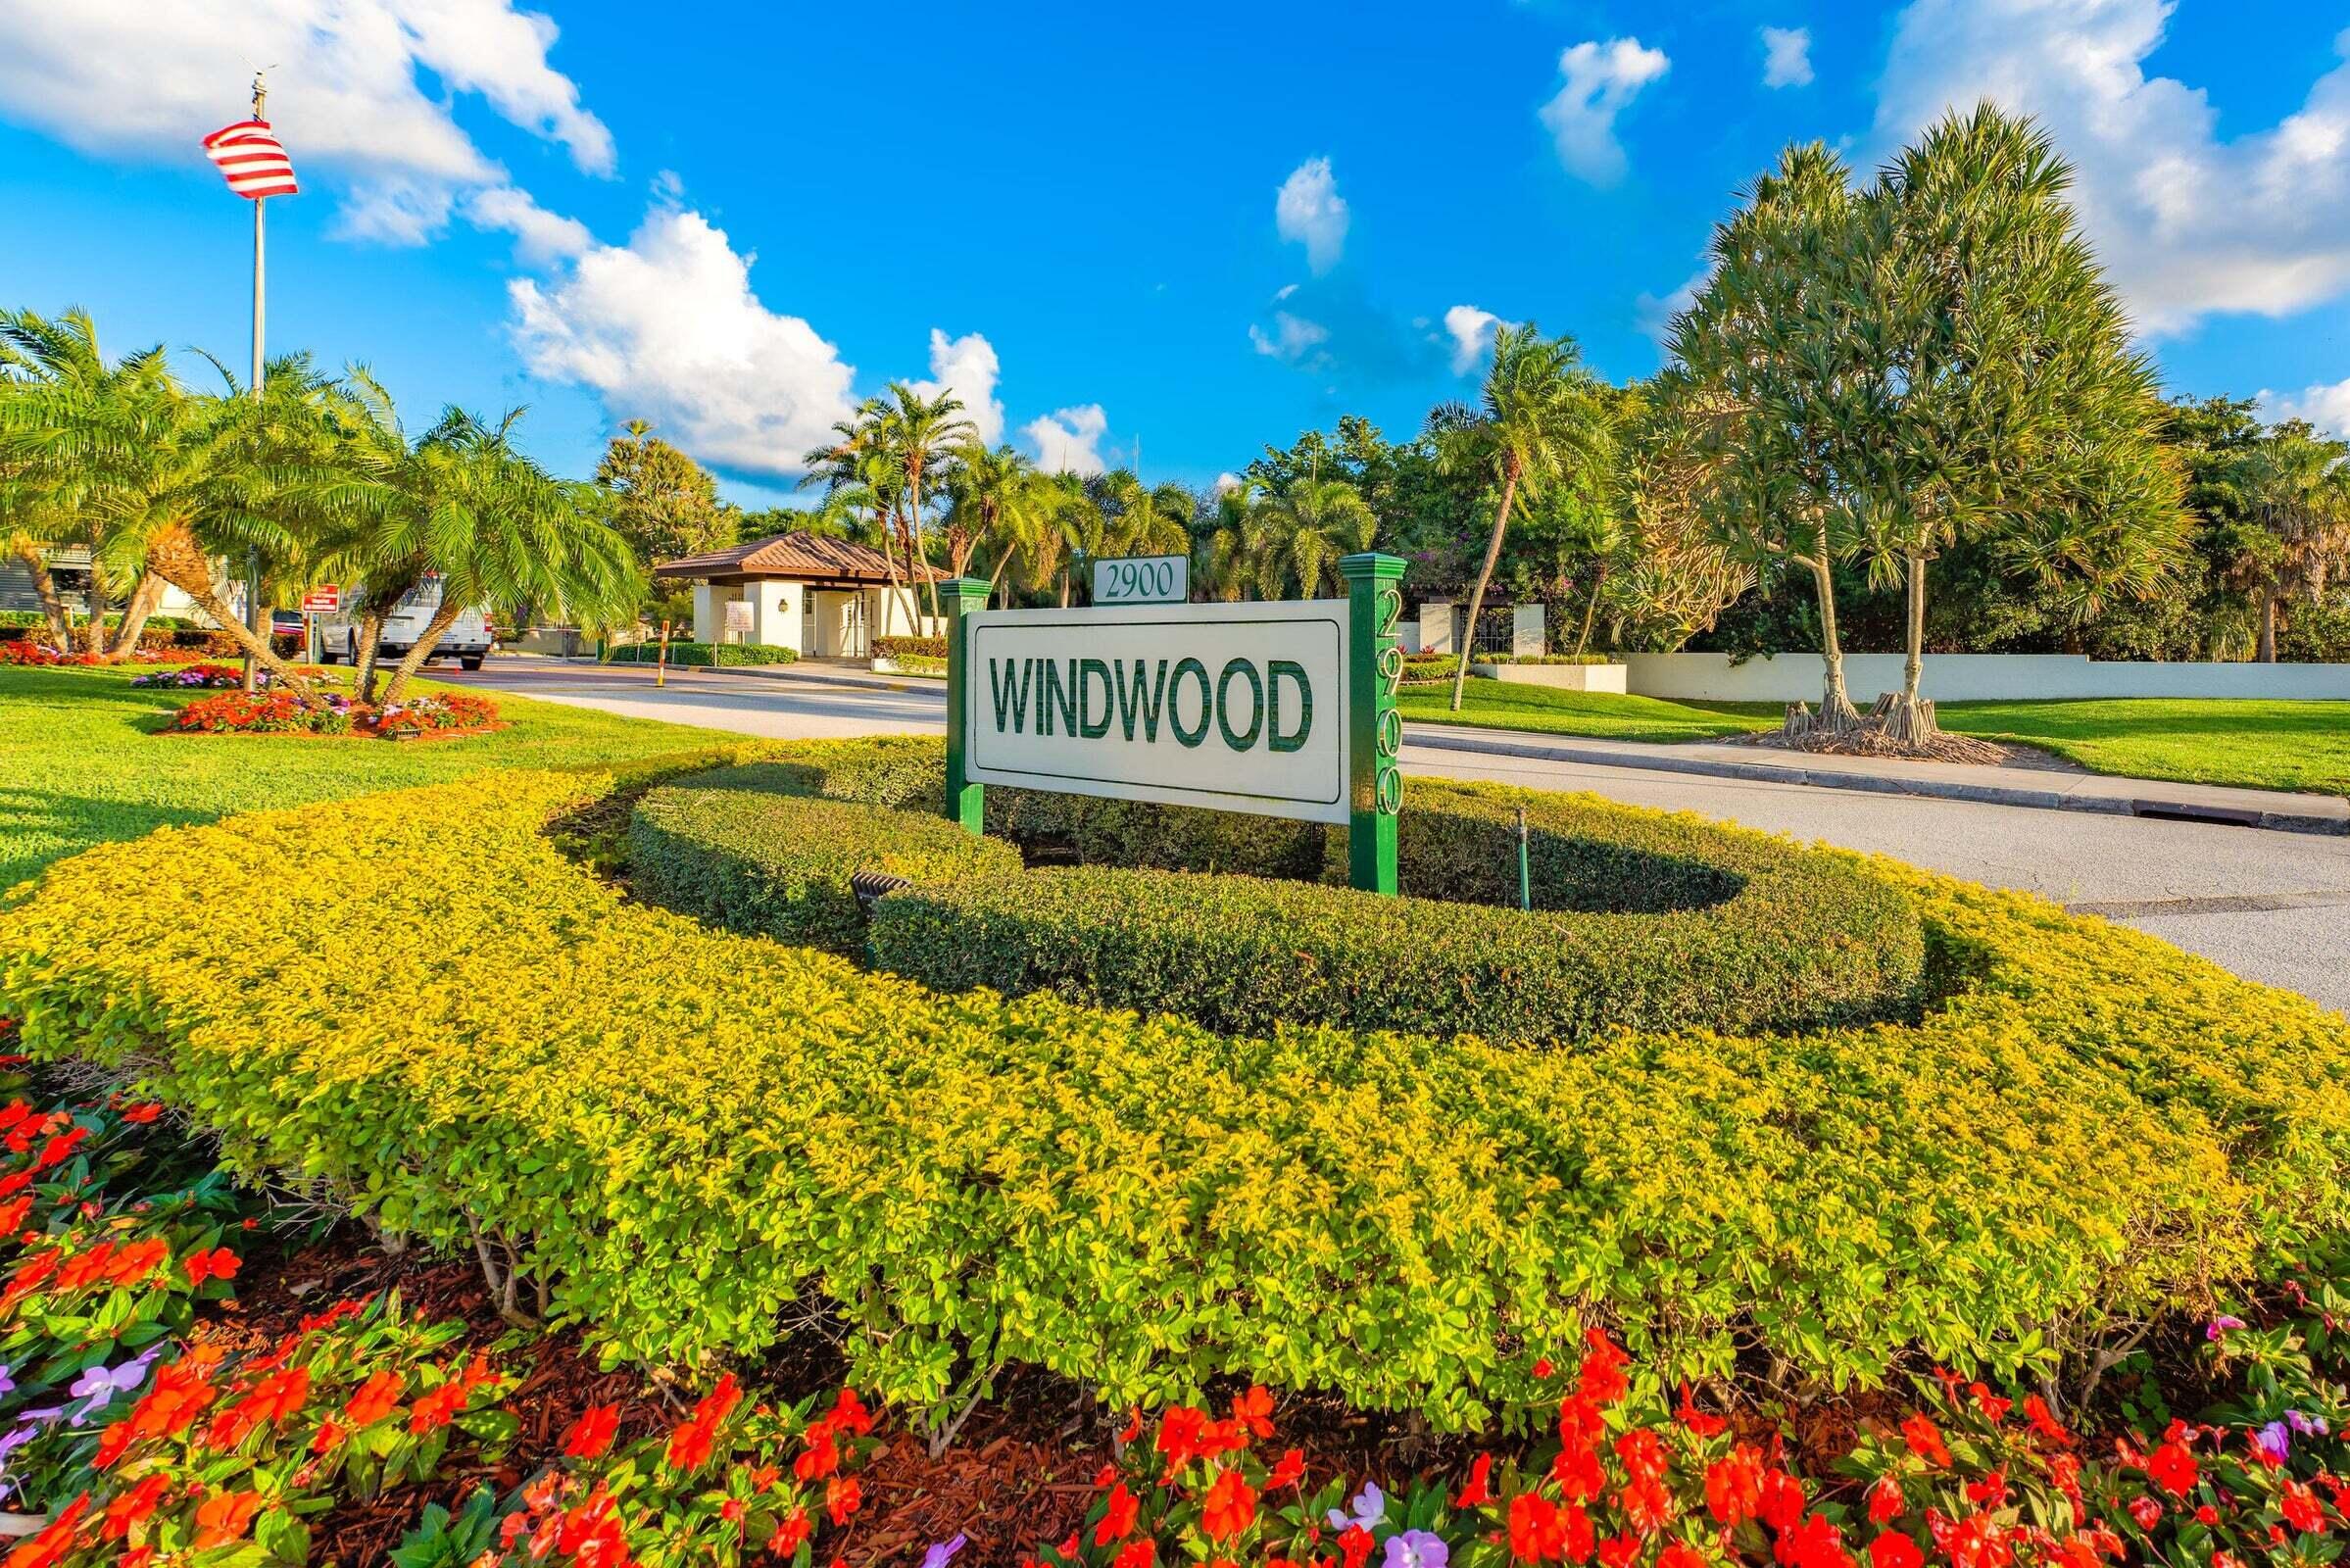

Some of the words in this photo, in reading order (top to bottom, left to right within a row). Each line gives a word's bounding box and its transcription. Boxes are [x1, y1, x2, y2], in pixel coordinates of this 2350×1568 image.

[1105, 562, 1173, 598] 2900
[989, 658, 1313, 753] WINDWOOD
[1377, 589, 1403, 814] 2900
